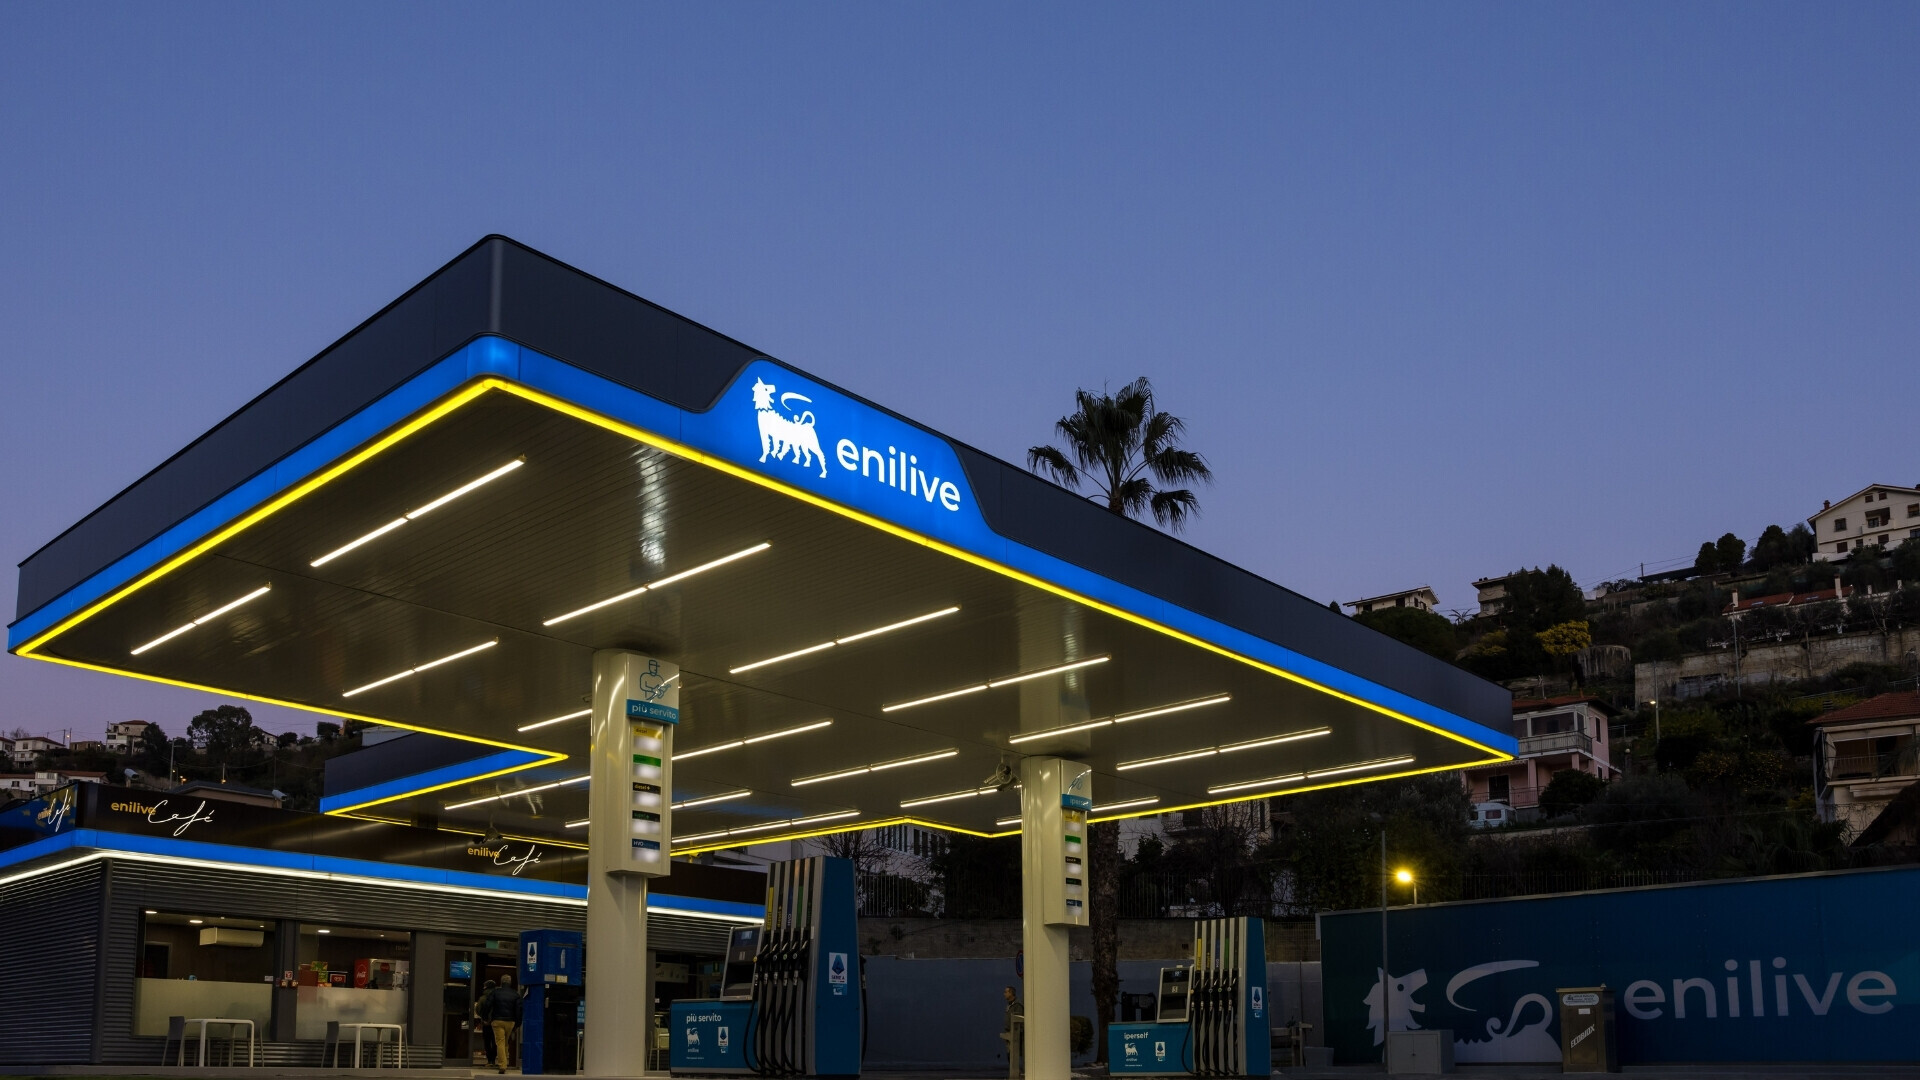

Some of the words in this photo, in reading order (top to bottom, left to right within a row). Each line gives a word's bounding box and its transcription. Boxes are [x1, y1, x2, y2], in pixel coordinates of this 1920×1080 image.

[836, 438, 961, 512] enilive
[632, 703, 648, 713] più
[649, 707, 677, 720] servito
[110, 801, 157, 816] enilive
[147, 799, 215, 837] Café
[467, 847, 500, 859] enilive
[493, 844, 542, 876] Café
[1623, 956, 1897, 1020] enilive
[686, 1013, 697, 1024] più
[698, 1013, 722, 1022] servito
[1123, 1031, 1149, 1041] iperself
